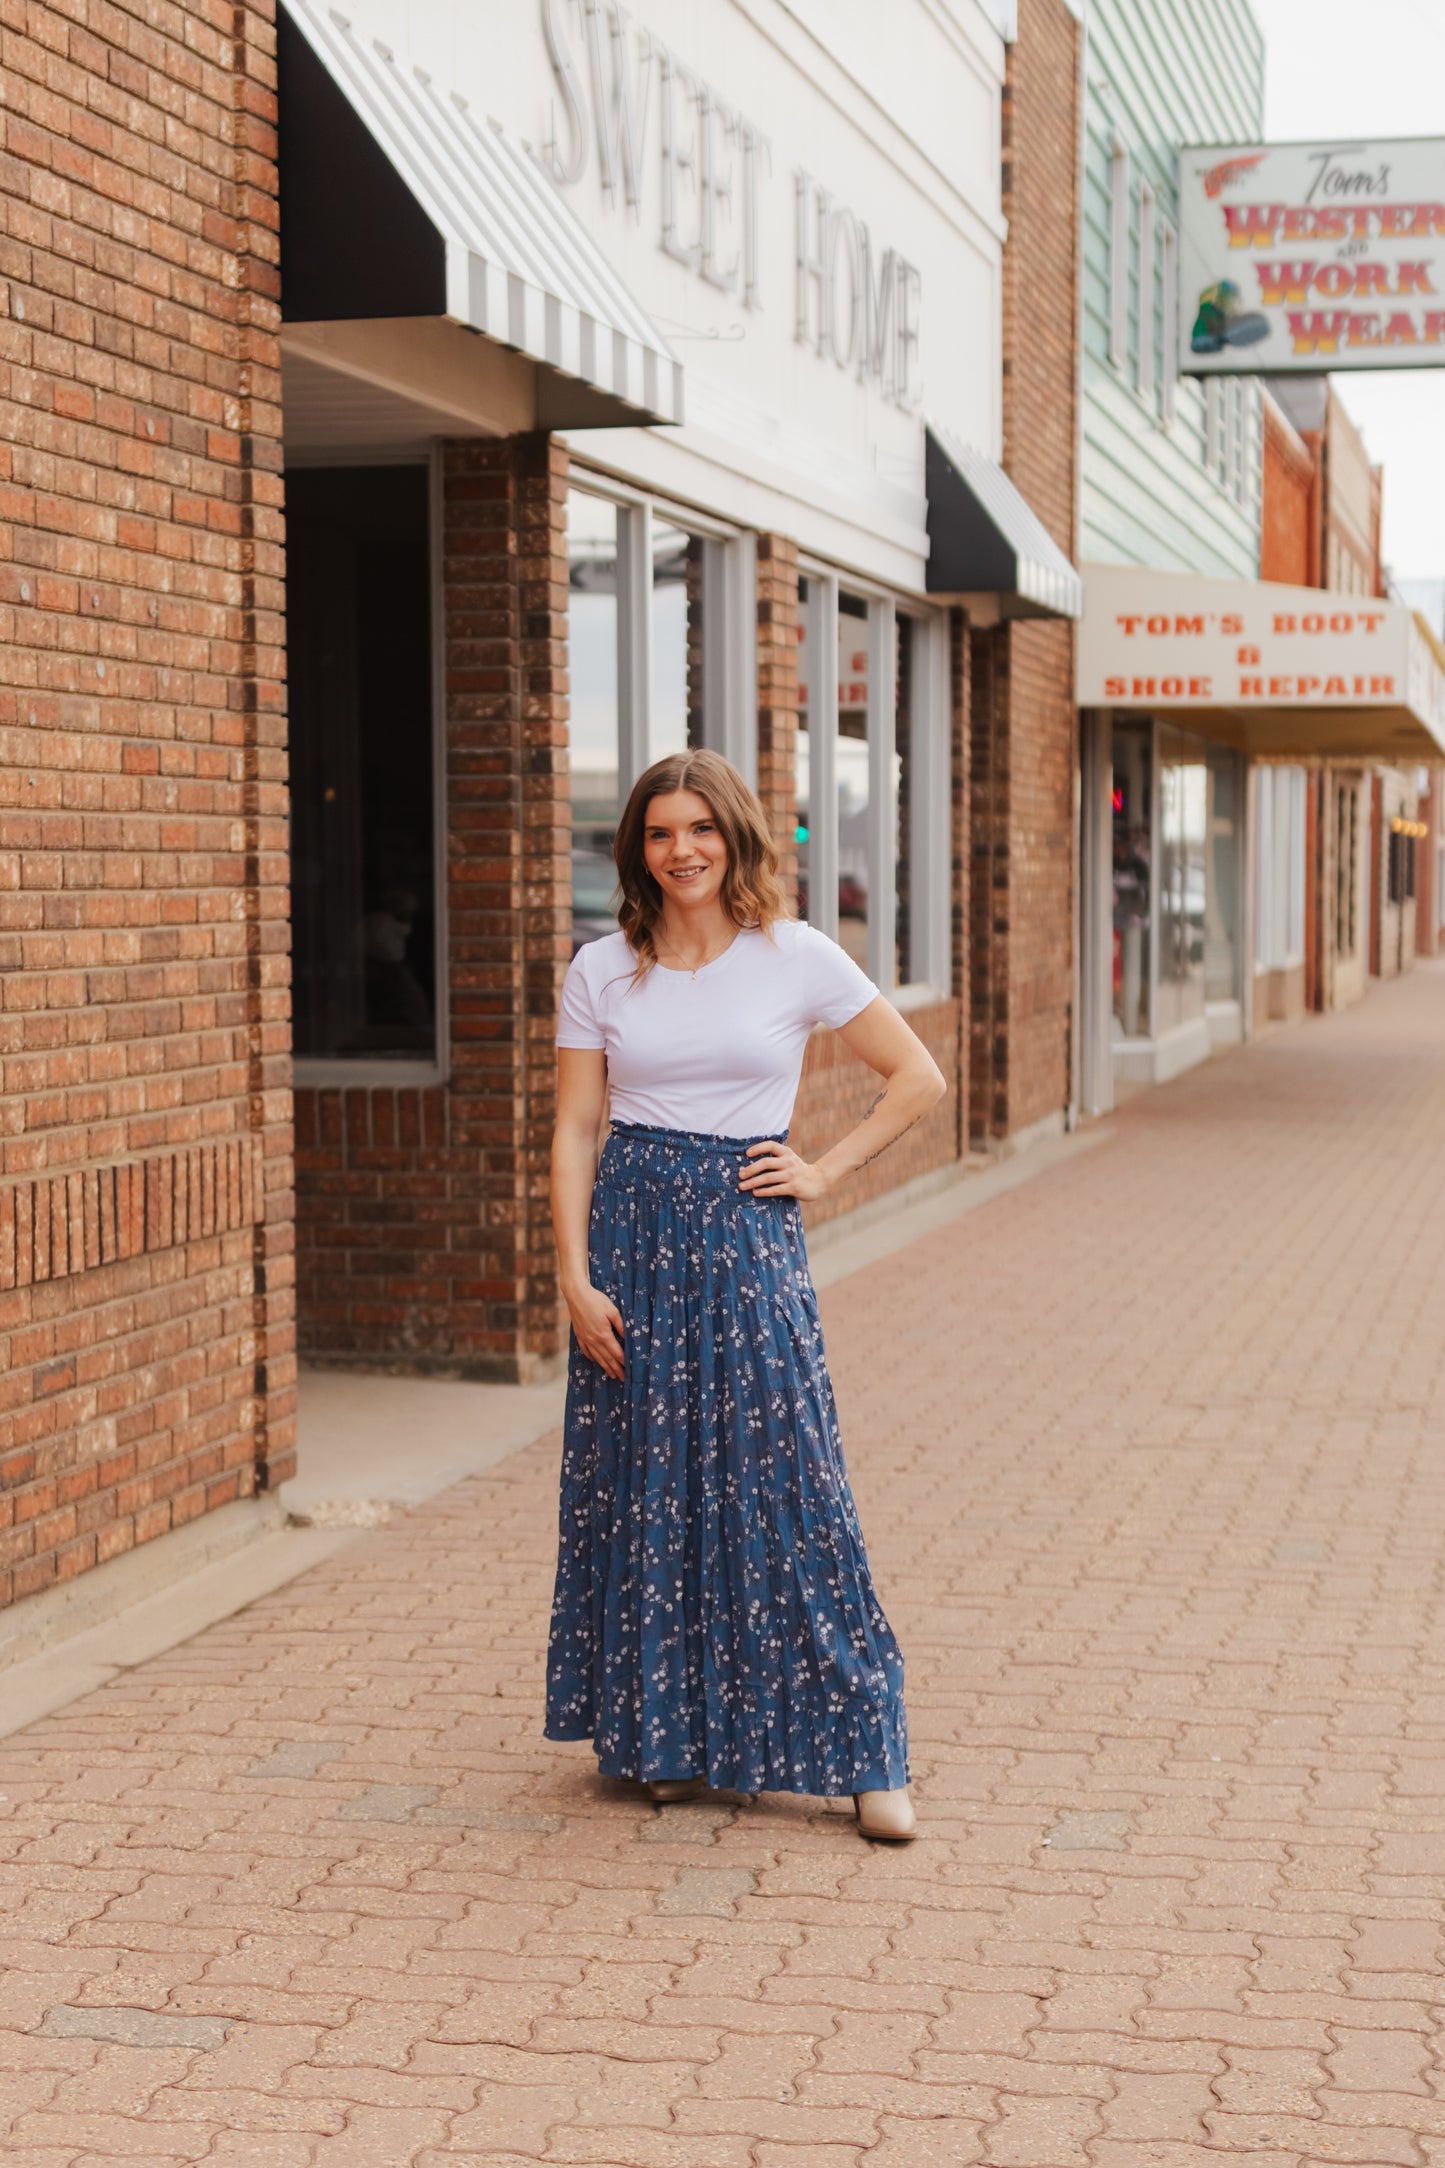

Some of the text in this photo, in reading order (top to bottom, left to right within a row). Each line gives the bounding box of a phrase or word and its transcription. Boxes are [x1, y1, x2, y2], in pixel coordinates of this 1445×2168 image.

[1306, 146, 1391, 204] Tom's
[537, 0, 923, 417] SWEET HOME
[1254, 259, 1438, 305] WORK
[1116, 611, 1385, 636] TOM'S BOOT
[1104, 674, 1395, 698] SHOE REPAIR
